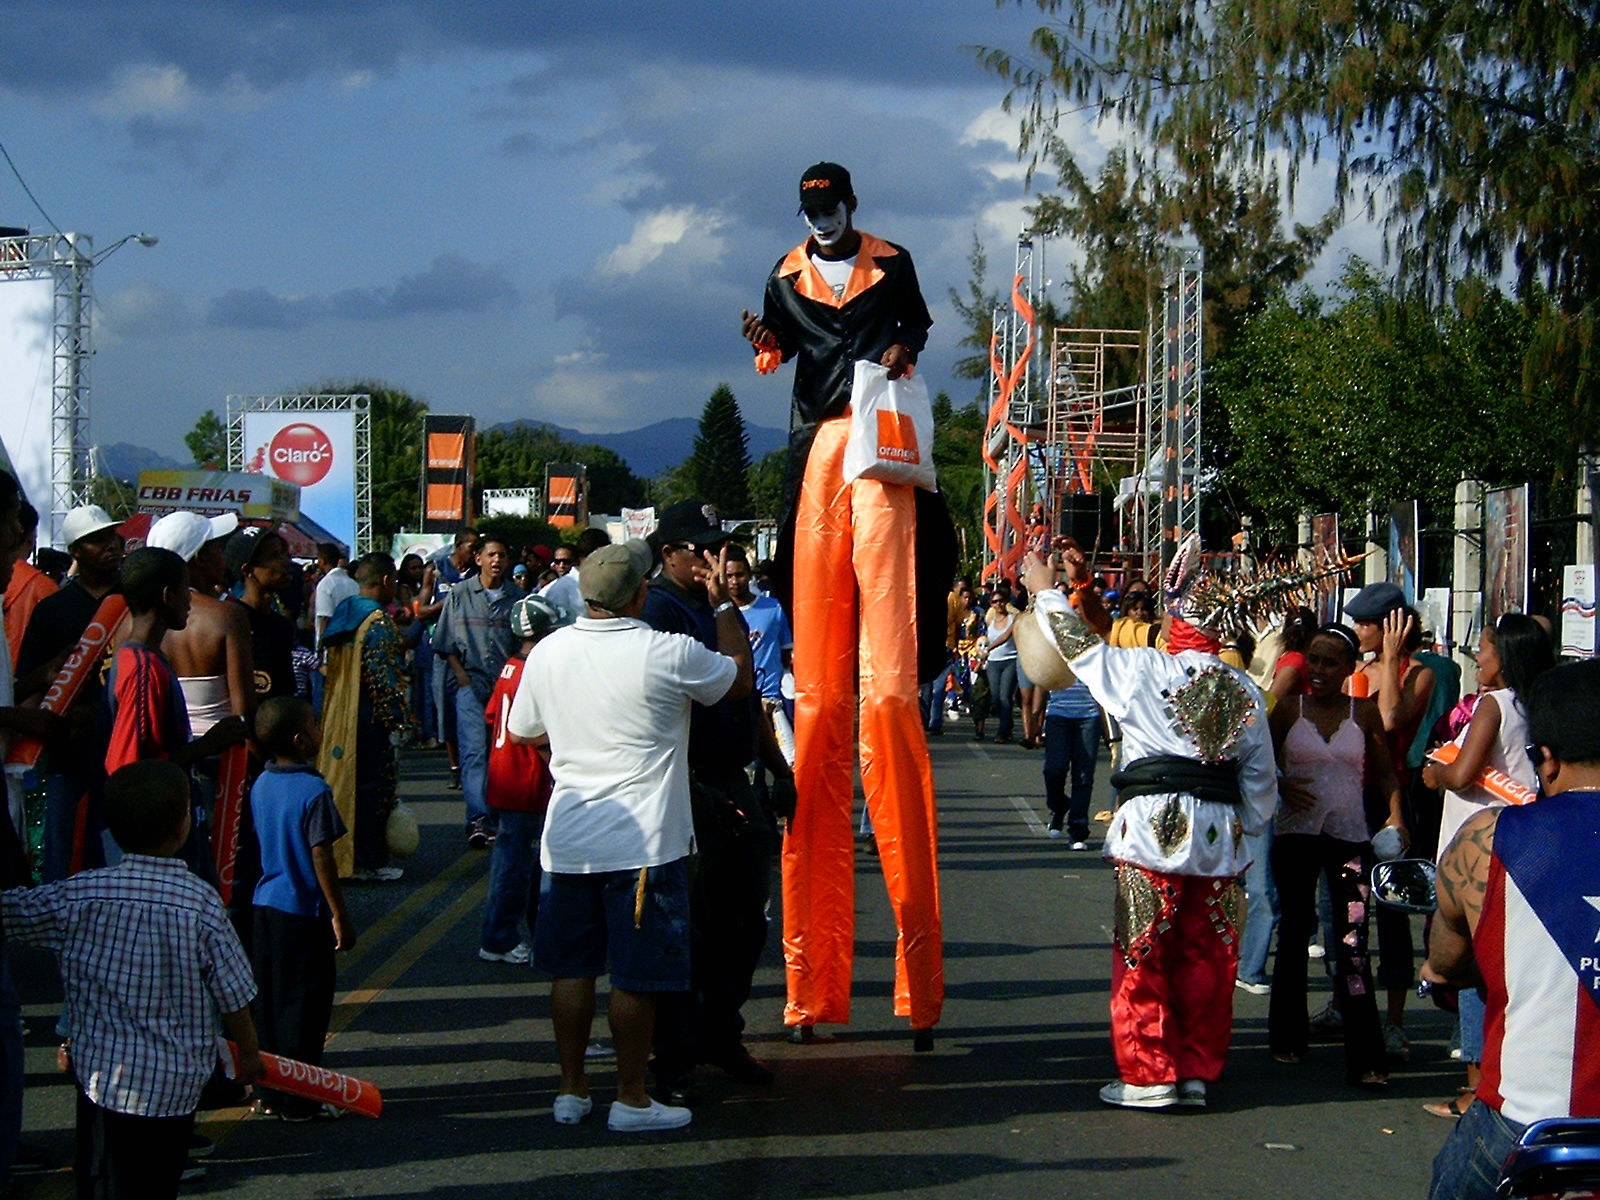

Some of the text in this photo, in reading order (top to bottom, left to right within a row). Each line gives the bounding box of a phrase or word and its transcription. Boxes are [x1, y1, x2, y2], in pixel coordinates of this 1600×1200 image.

[274, 448, 321, 463] Claro
[879, 446, 915, 461] orange
[139, 486, 252, 503] CBB FRIAS
[278, 1058, 361, 1103] Orange
